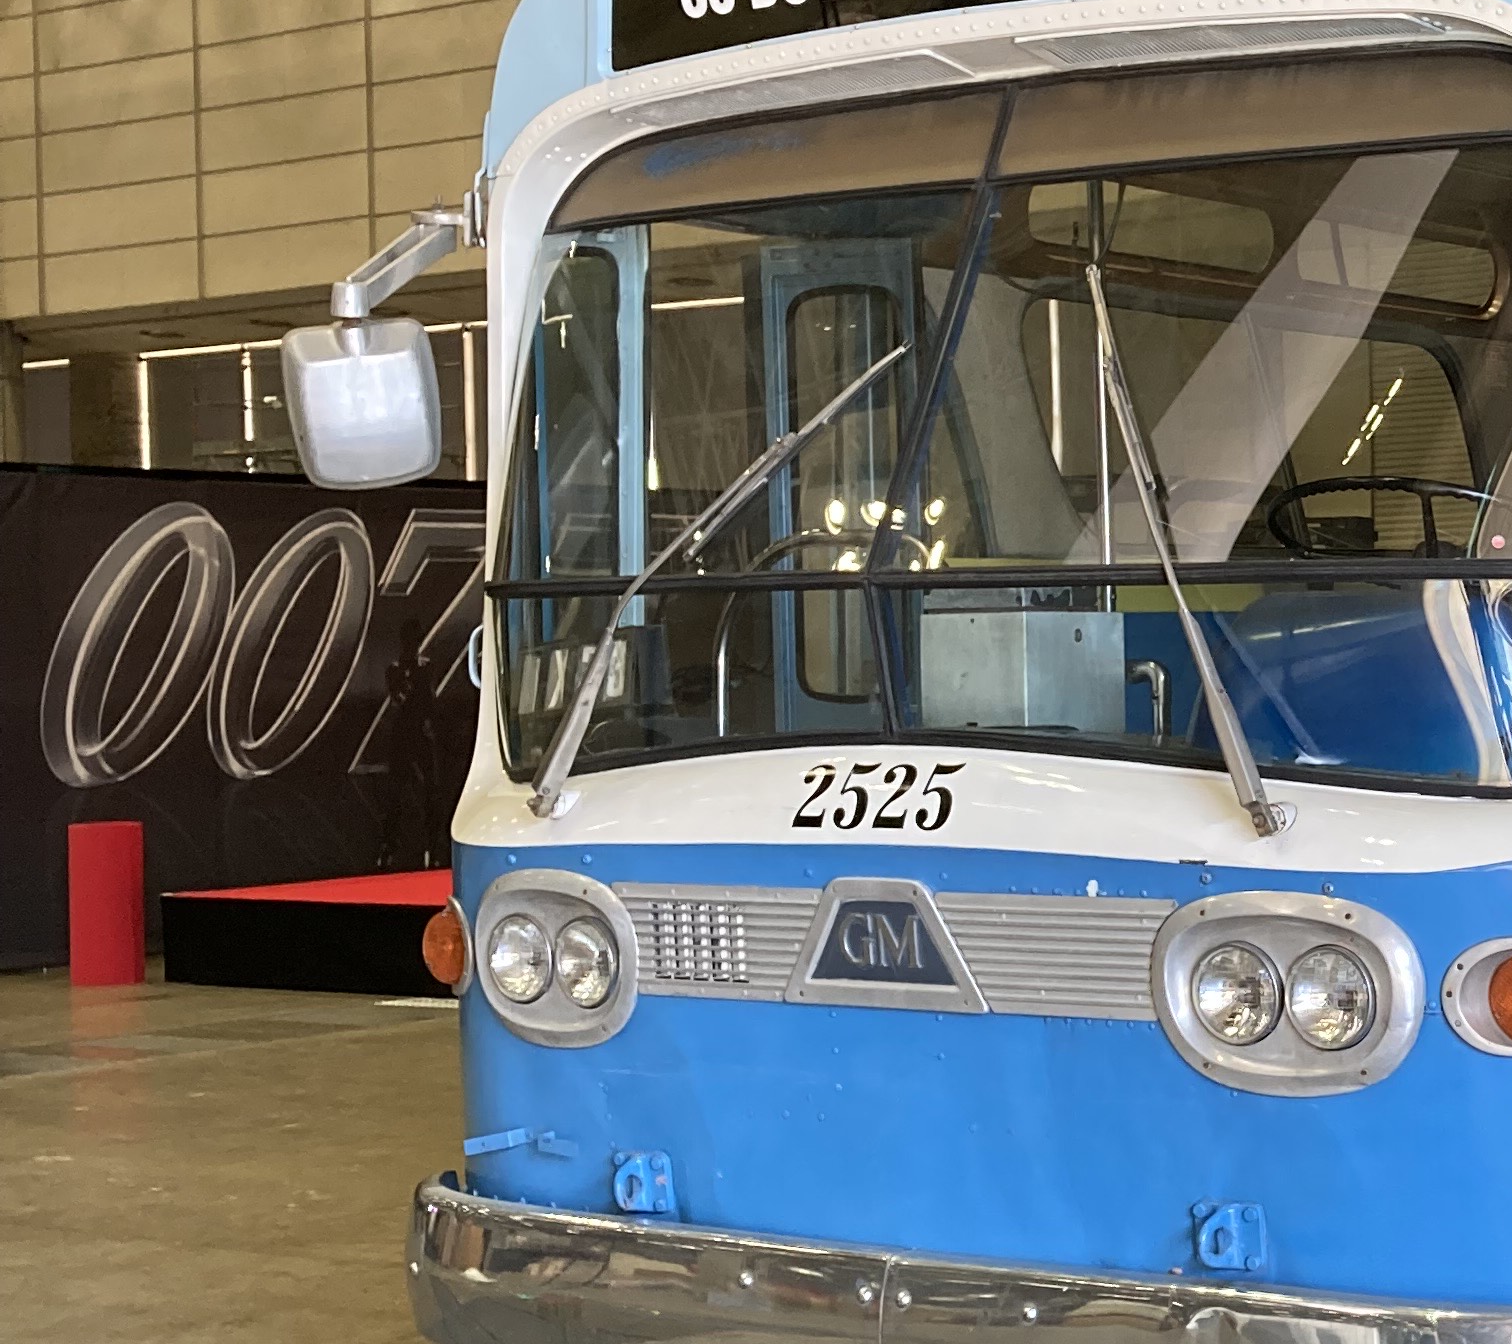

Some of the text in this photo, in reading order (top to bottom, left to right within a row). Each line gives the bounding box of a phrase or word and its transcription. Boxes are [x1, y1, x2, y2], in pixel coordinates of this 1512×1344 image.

[40, 502, 487, 787] 007
[792, 762, 967, 831] 2525
[838, 912, 925, 970] GM
